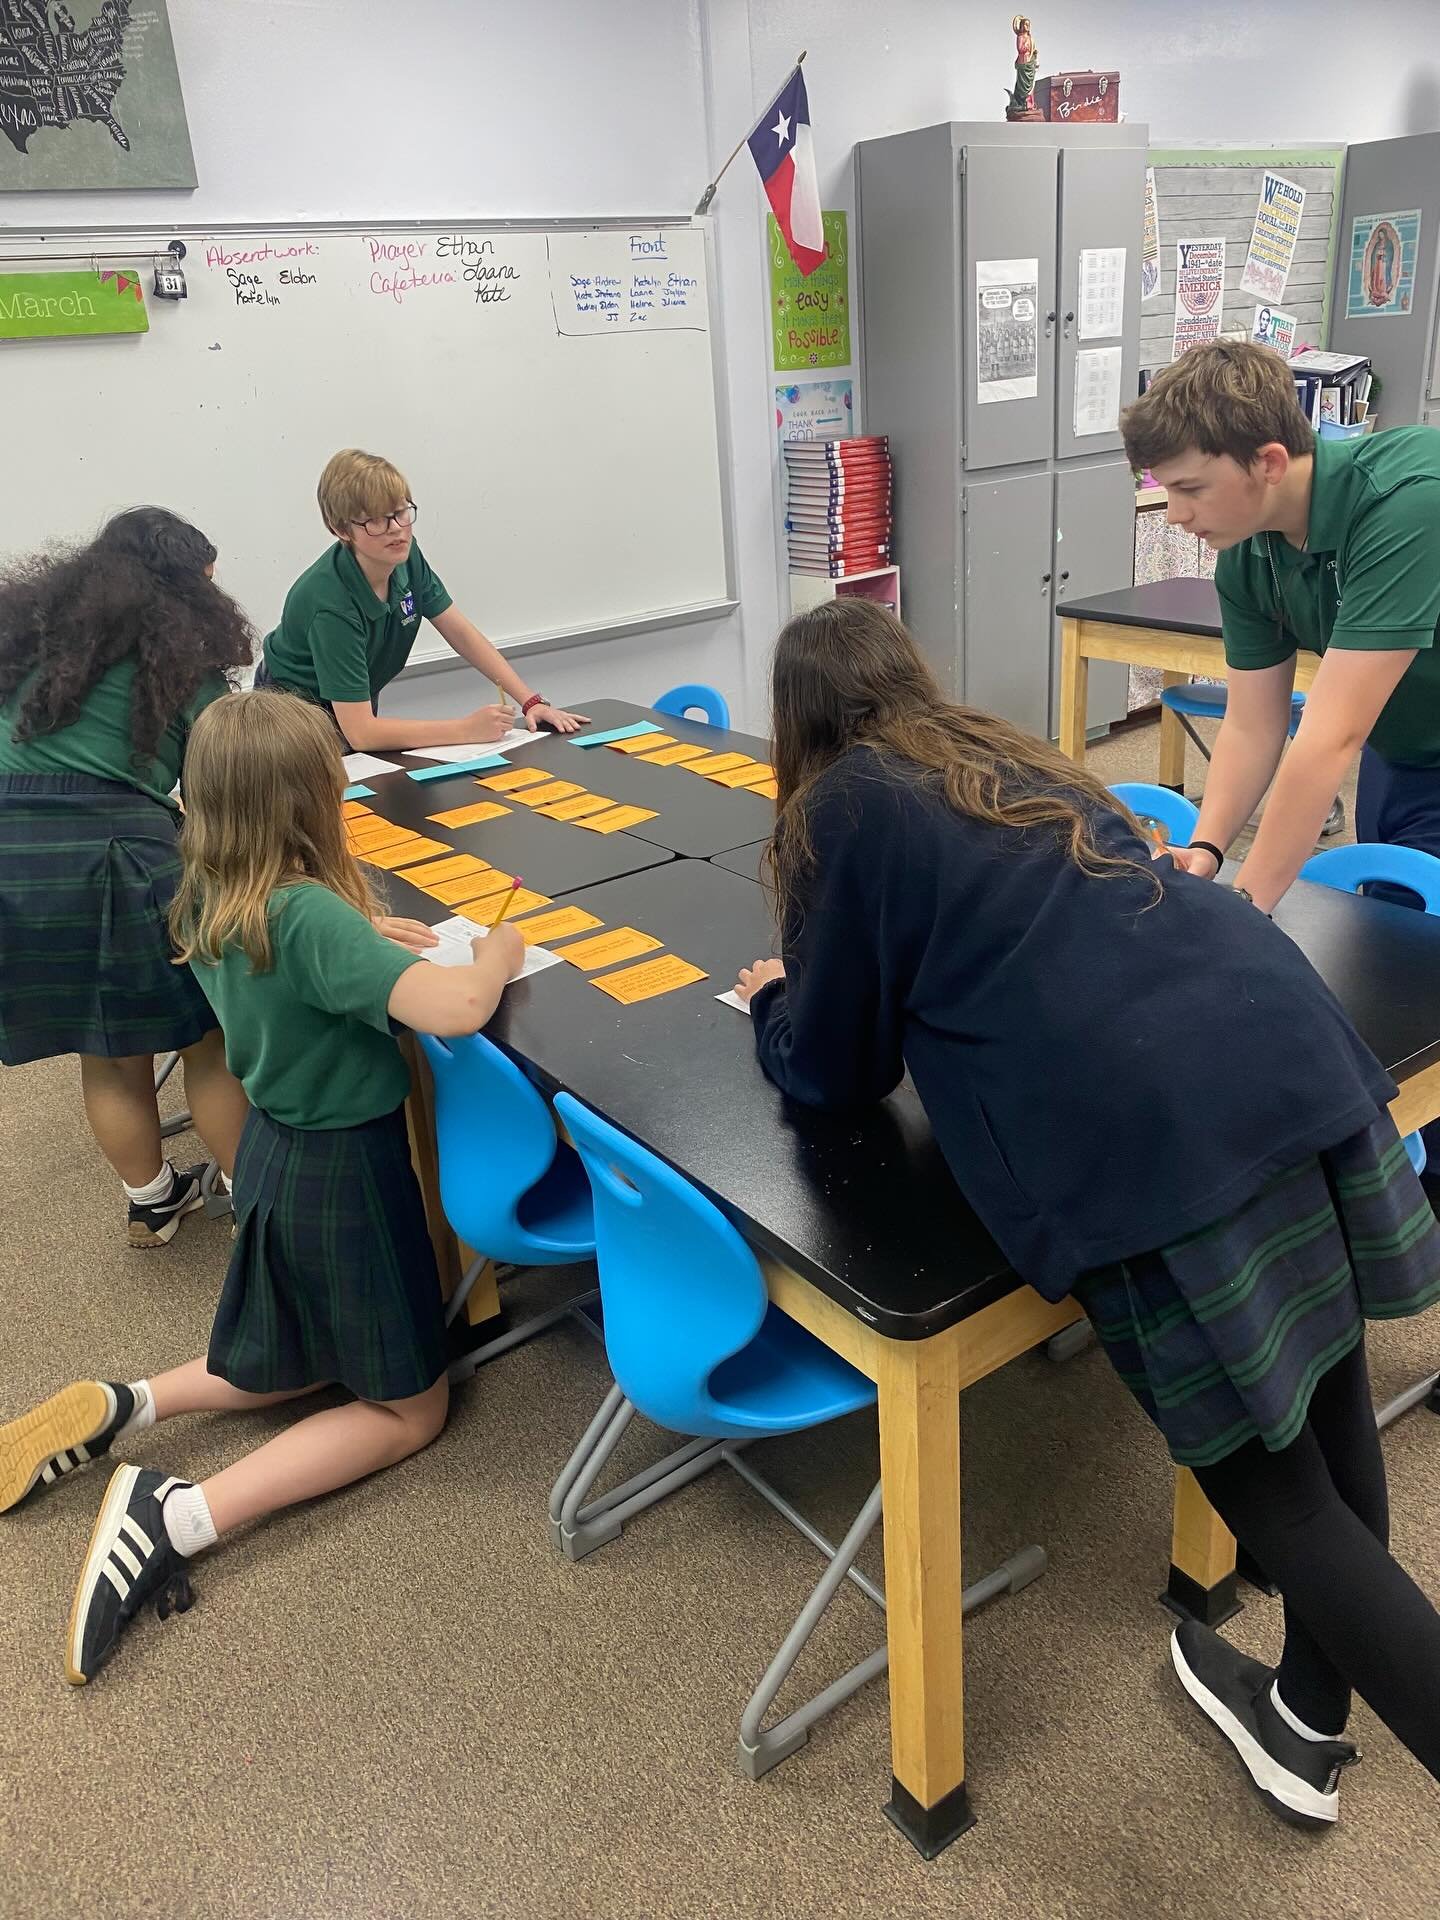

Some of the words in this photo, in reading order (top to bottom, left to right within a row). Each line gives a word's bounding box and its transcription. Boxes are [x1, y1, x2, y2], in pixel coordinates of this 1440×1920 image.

[0, 103, 37, 132] exas
[364, 235, 428, 270] Prayer
[436, 235, 495, 257] Ethan
[629, 232, 666, 253] Front
[1189, 252, 1217, 260] December
[165, 278, 178, 290] 31
[227, 267, 262, 294] Sage
[279, 267, 317, 285] Eldon
[667, 273, 697, 287] Ethan
[1178, 281, 1221, 293] AMERICA
[473, 282, 511, 303] Kate
[795, 290, 829, 312] easy
[0, 290, 97, 320] March
[1276, 331, 1292, 344] THIS
[788, 418, 814, 430] THANK
